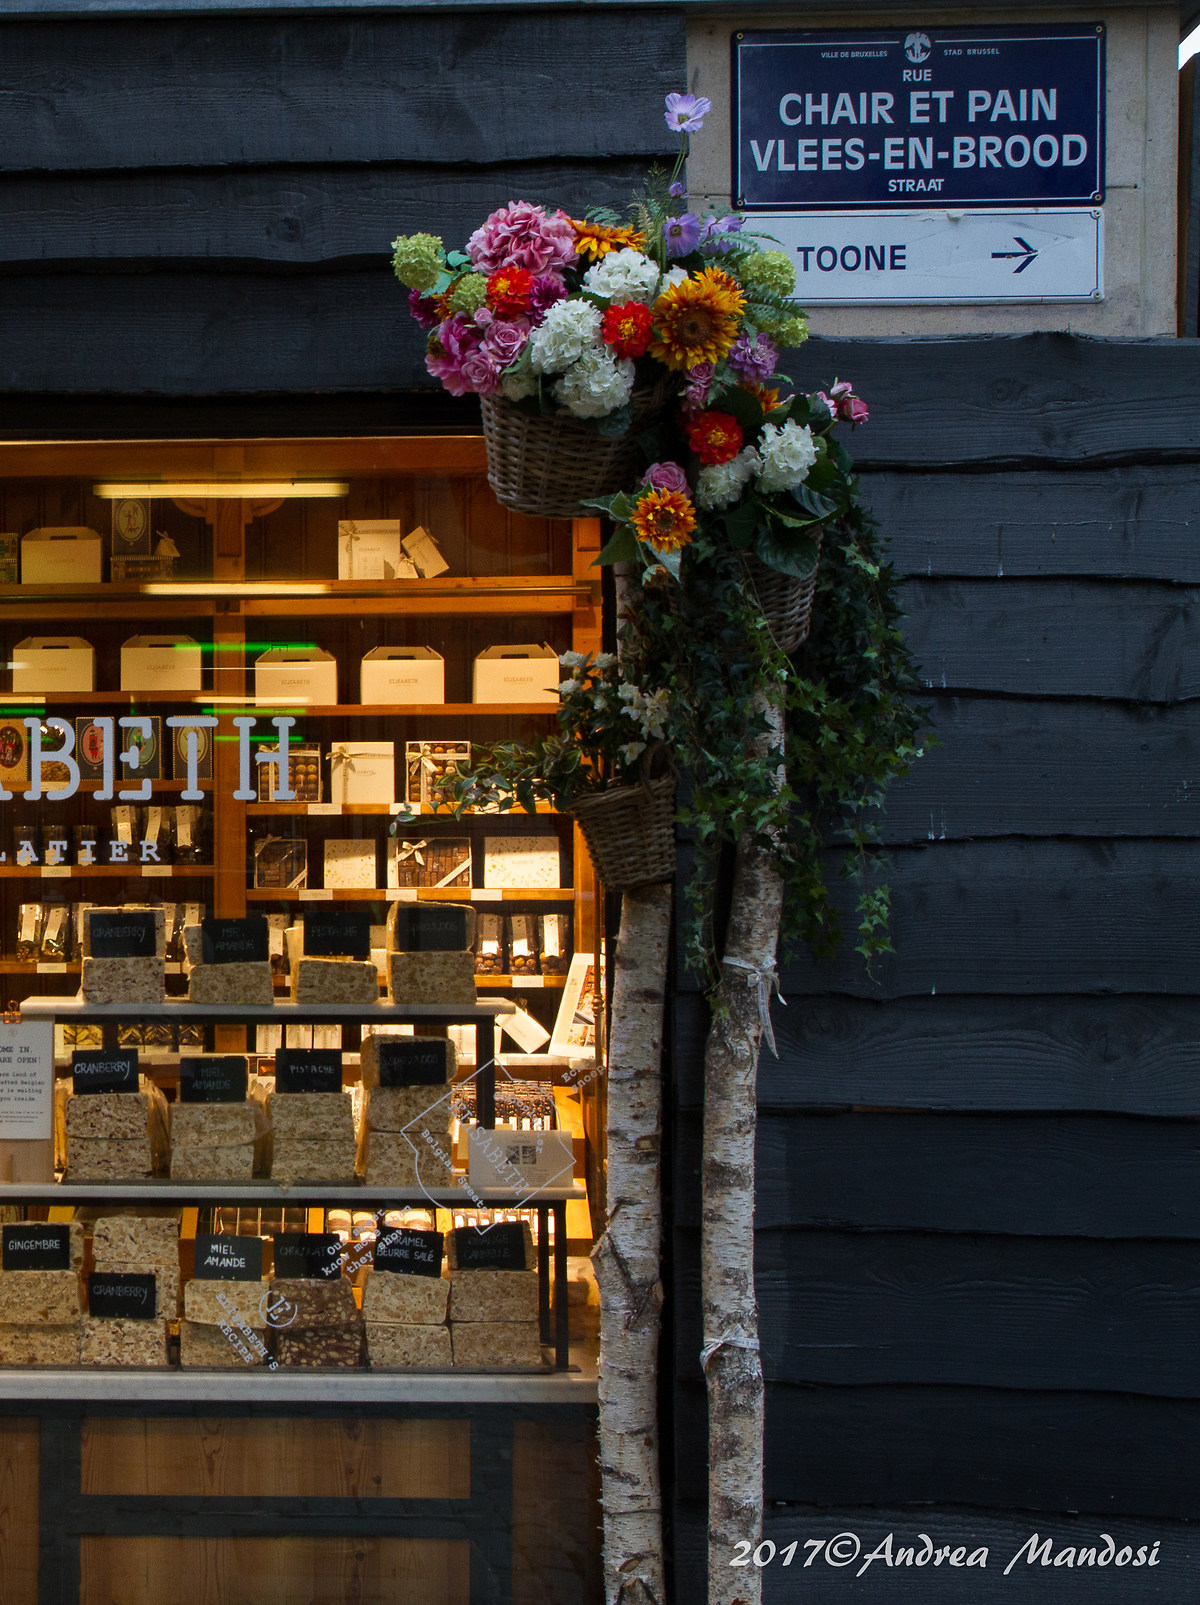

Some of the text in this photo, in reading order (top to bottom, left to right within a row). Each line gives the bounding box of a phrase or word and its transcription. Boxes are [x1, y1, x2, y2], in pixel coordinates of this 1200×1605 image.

[903, 69, 932, 82] RUE
[779, 88, 1057, 126] CHAIR ET PAIN
[750, 134, 1088, 172] VLEES-EN-BROOD
[888, 179, 944, 192] STRAAT
[796, 245, 906, 272] TOONE
[204, 1256, 245, 1268] AMANDE
[321, 1252, 350, 1276] know
[346, 1250, 374, 1273] they
[217, 1319, 254, 1363] RECIPE
